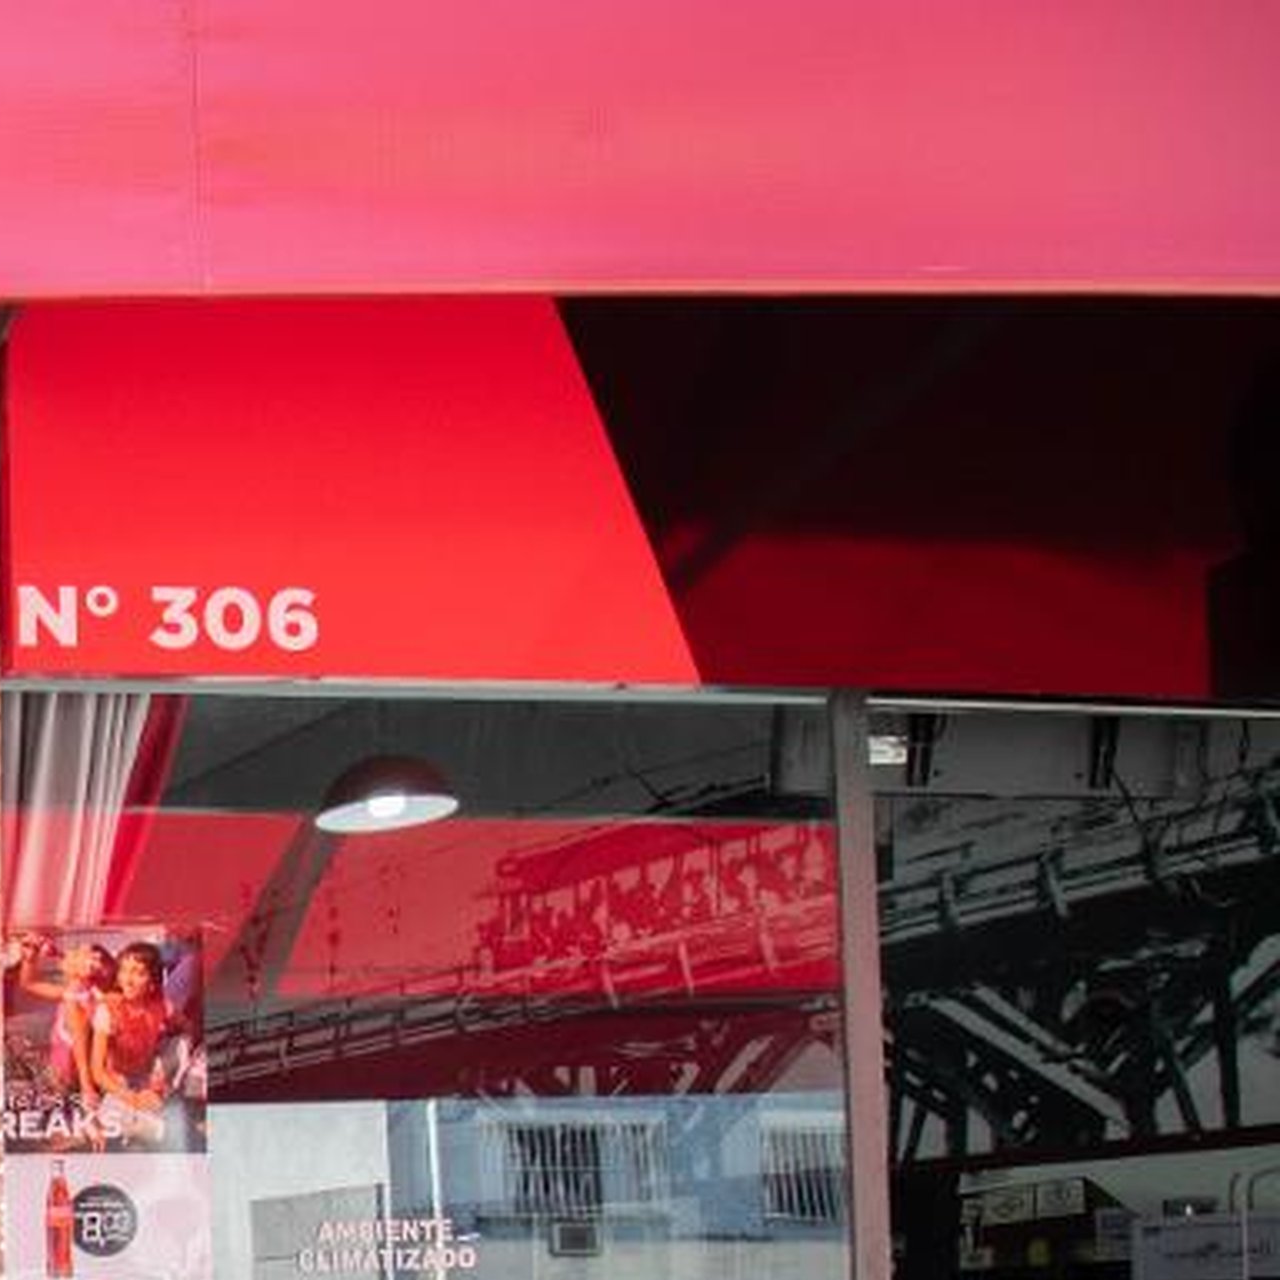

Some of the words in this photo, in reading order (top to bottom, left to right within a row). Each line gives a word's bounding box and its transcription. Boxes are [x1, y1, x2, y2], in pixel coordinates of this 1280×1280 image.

[148, 585, 318, 651] 306
[318, 1218, 454, 1241] AMBIENTE
[299, 1247, 478, 1273] CLIMATIZADO
